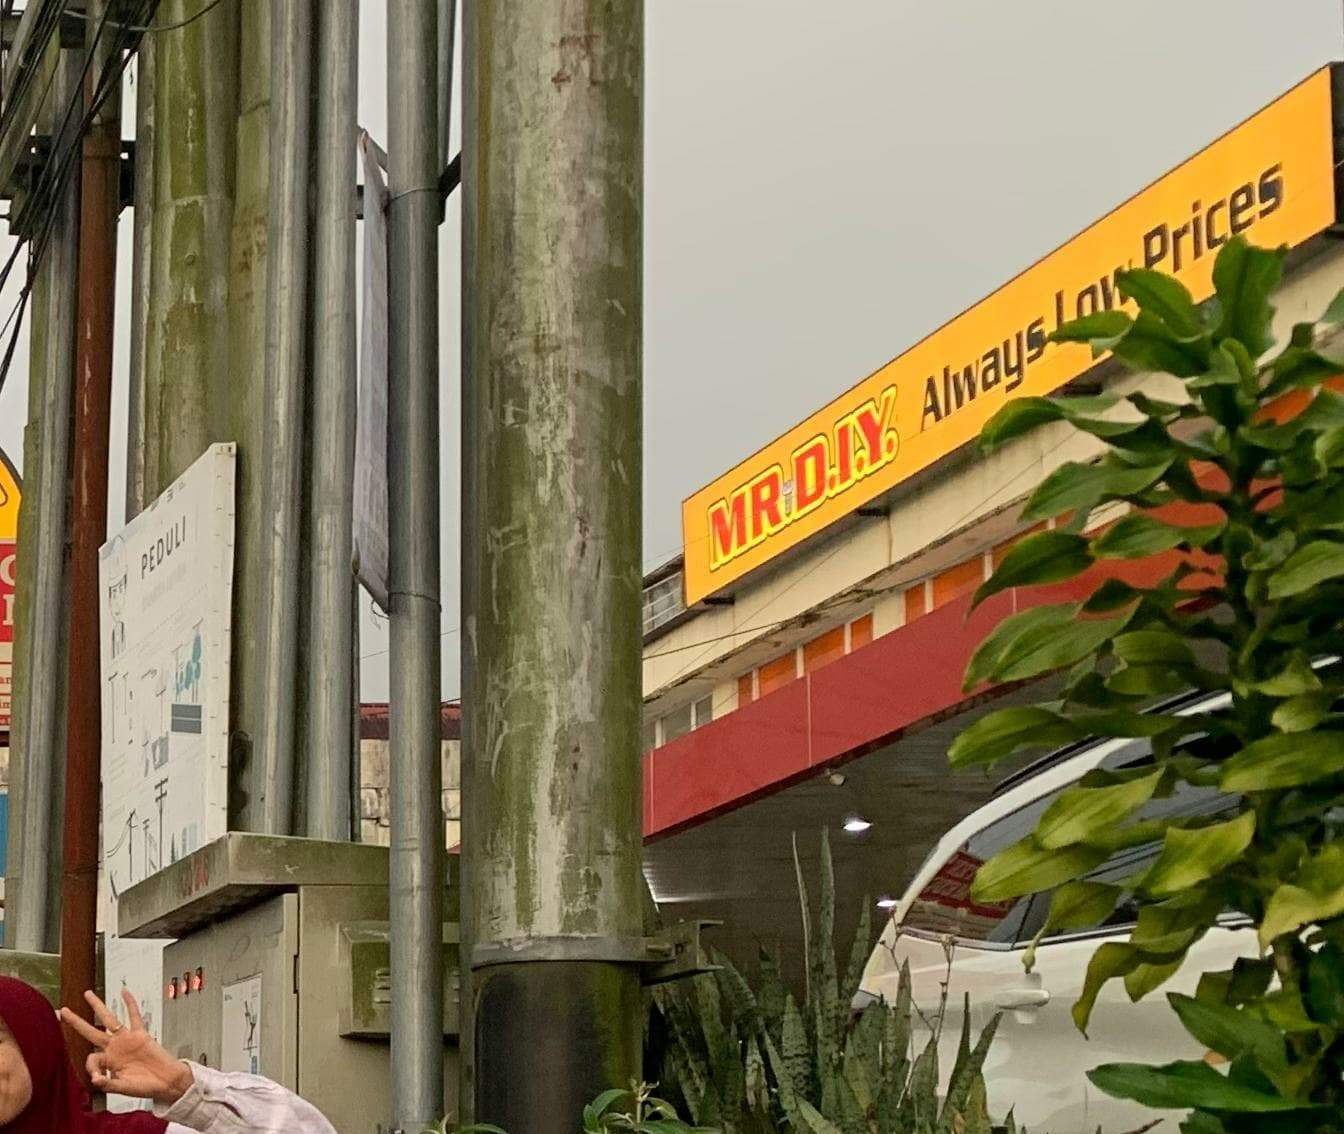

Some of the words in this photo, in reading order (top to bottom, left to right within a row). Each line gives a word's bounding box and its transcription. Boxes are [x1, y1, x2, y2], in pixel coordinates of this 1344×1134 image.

[920, 317, 1046, 434] Always
[1142, 163, 1285, 274] Prices
[141, 515, 186, 580] PEDULI
